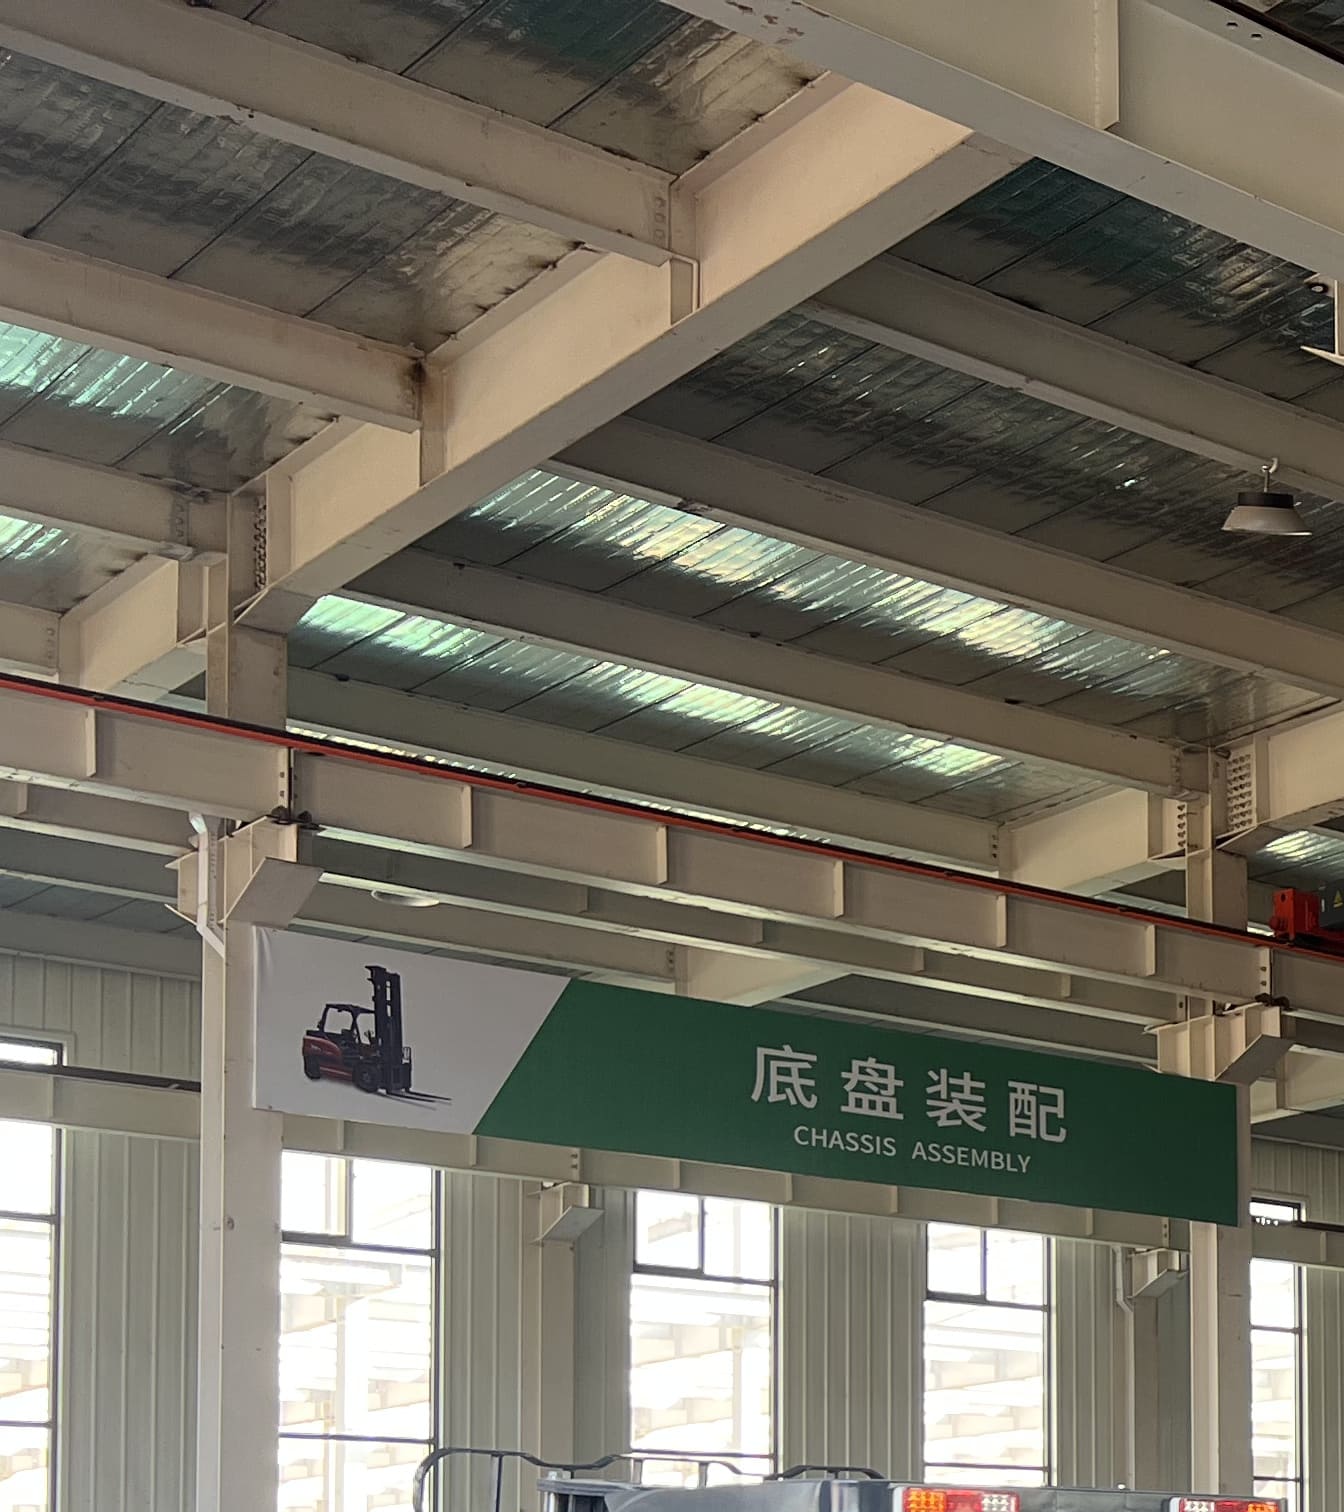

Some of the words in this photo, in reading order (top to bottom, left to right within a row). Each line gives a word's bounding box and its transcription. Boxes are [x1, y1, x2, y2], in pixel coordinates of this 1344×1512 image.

[751, 1045, 1067, 1143] 底盘装配
[793, 1126, 897, 1156] CHASSIS
[911, 1141, 1031, 1173] ASSEMBLY
